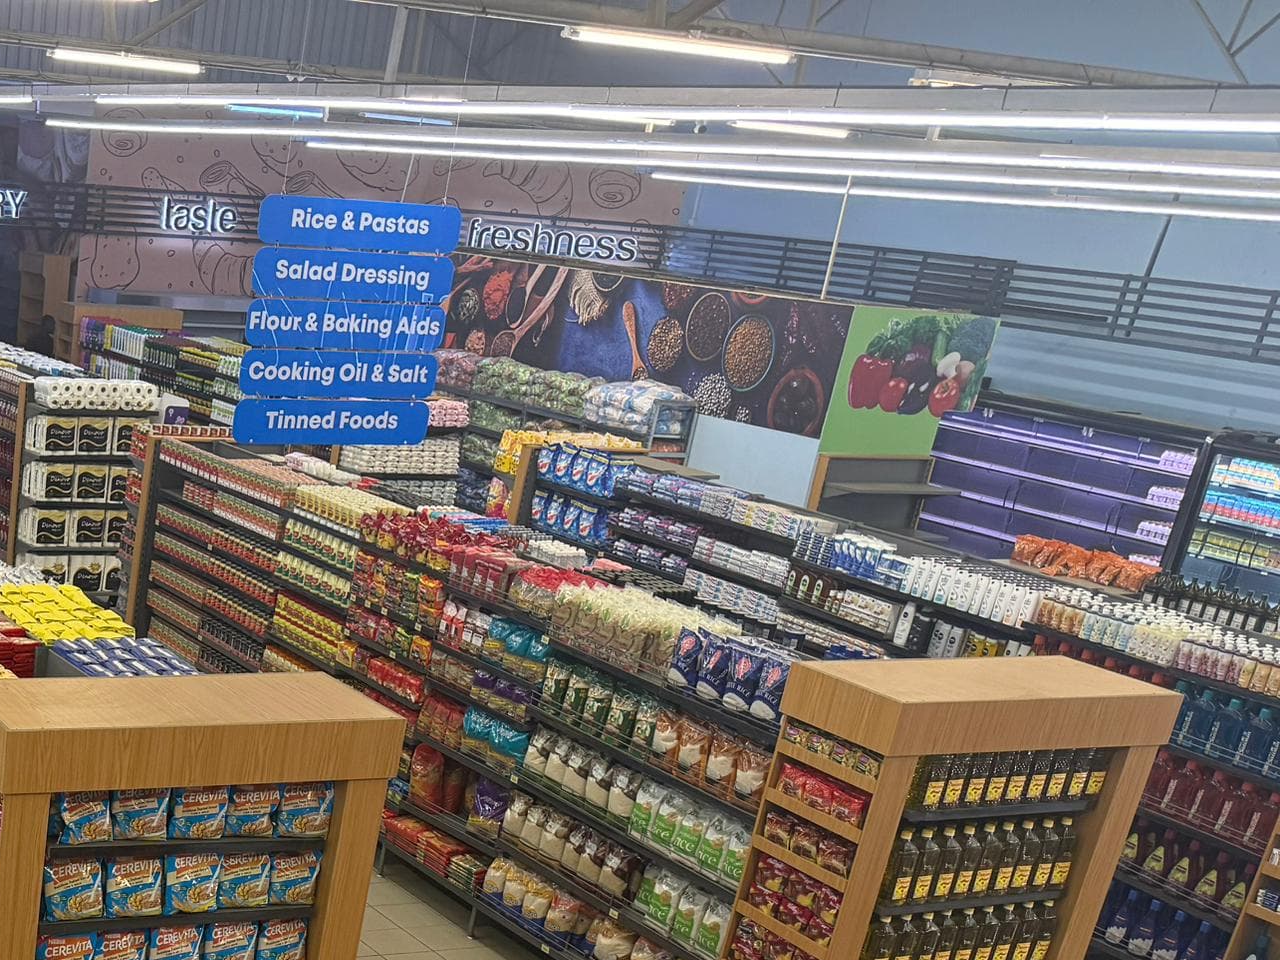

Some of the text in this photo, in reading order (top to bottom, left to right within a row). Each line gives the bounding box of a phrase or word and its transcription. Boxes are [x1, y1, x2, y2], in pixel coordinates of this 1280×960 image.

[161, 195, 237, 234] taste
[291, 207, 430, 235] Rice & Pastas
[467, 217, 638, 262] freshness
[276, 259, 430, 291] Salad Dressing
[249, 311, 440, 339] Flour & Baking Aids
[248, 361, 428, 386] Cooking Oil & Salt
[266, 410, 398, 430] Tinned Foods
[181, 790, 229, 803] CEREVITA
[233, 789, 280, 803] CEREVITA
[114, 858, 161, 875] CEREVITA
[174, 852, 219, 868] CEREVITA
[273, 854, 317, 868] CEREVITA
[155, 928, 199, 945] CEREVITA
[264, 920, 305, 936] CEREVITA
[44, 940, 93, 957] CEREVITA
[100, 935, 145, 951] CEREVITA
